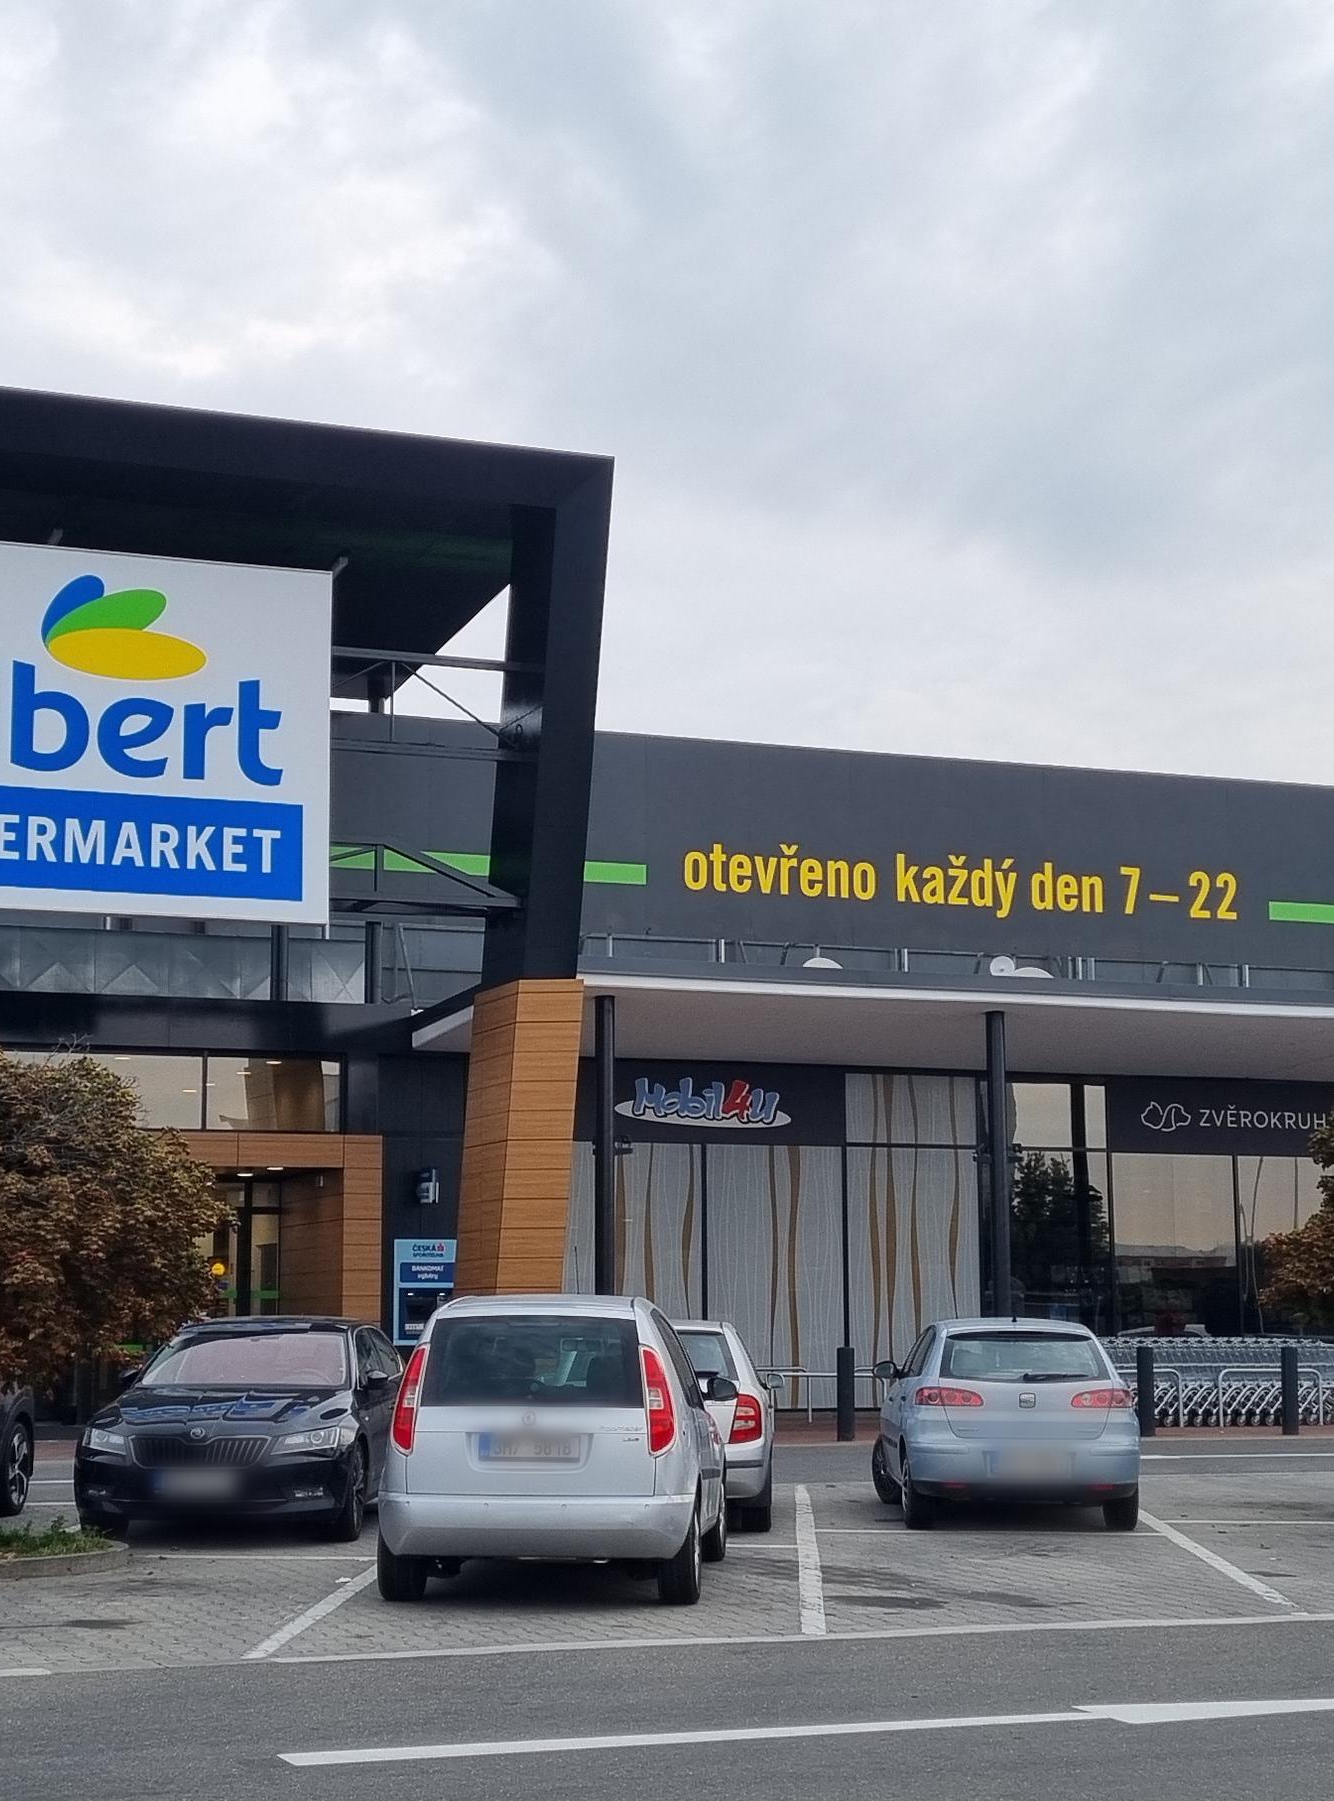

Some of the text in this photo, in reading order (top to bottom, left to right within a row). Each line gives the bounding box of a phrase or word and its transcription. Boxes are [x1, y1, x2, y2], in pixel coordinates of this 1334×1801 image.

[683, 843, 876, 900] otevřeno
[896, 853, 1017, 918] každý
[1031, 862, 1104, 913] den
[1199, 1104, 1328, 1130] ZVĚROKRUH
